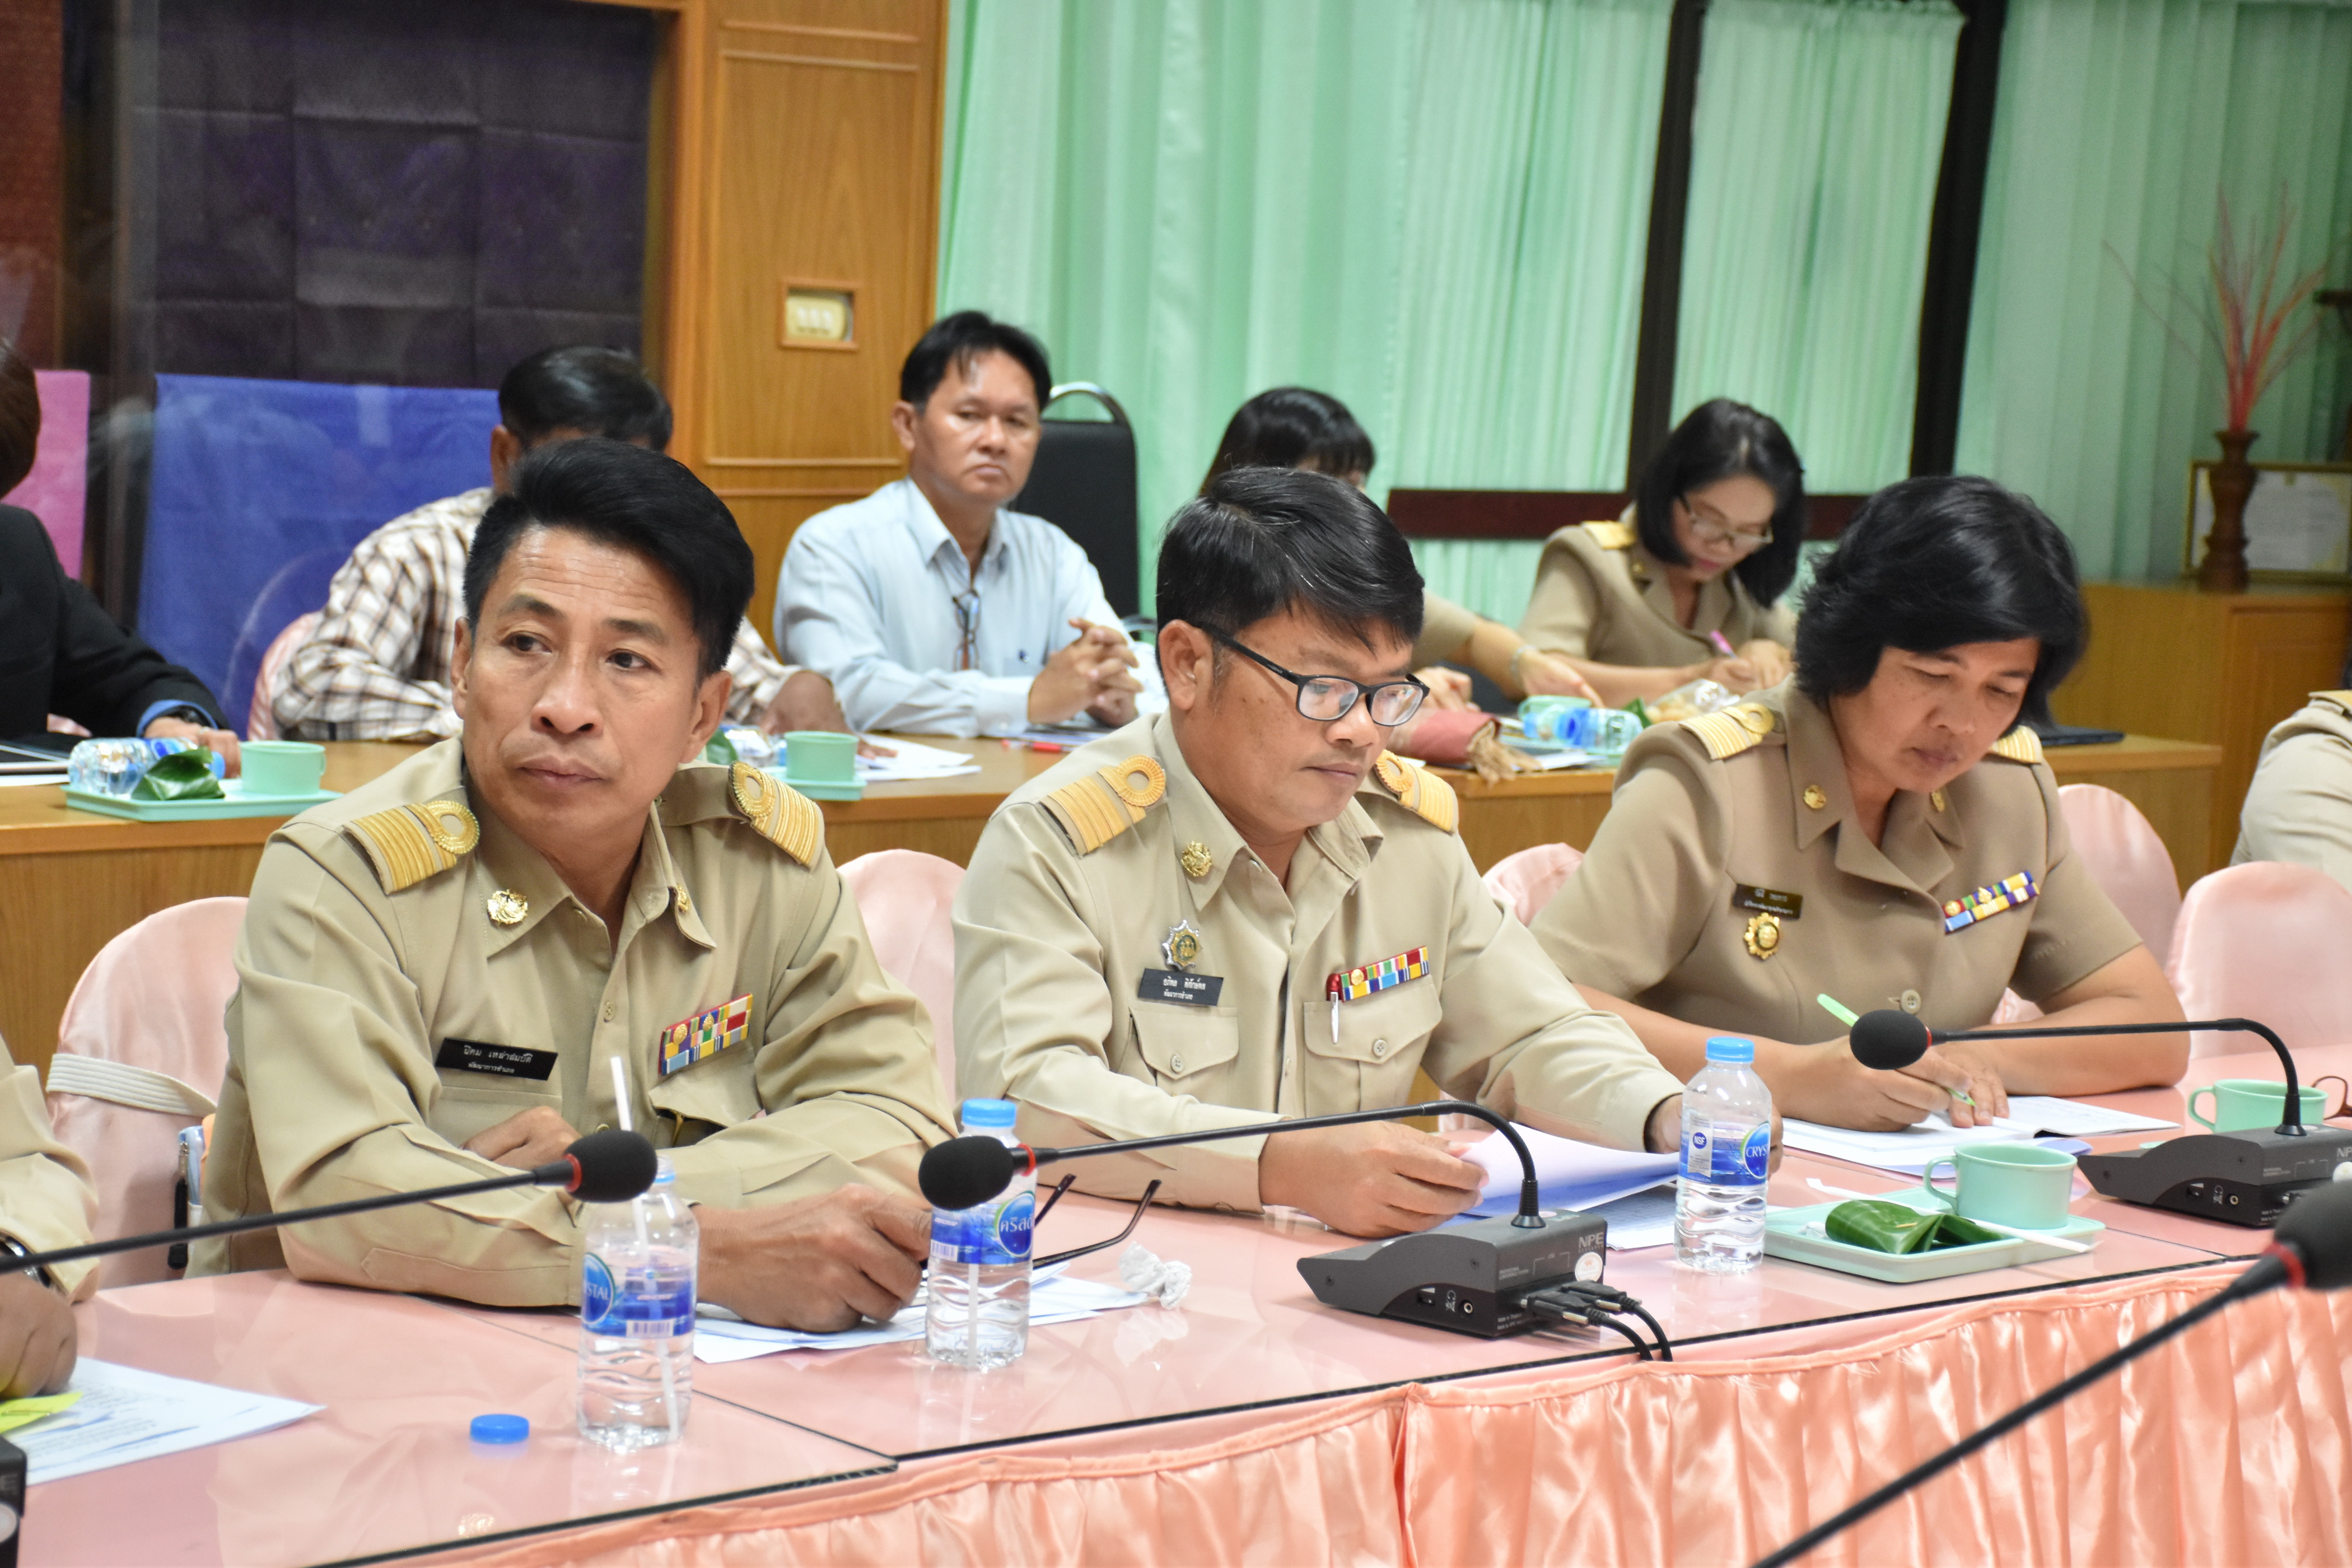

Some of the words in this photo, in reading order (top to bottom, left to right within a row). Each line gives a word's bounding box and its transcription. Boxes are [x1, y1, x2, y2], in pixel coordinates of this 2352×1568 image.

[1693, 1136, 1705, 1146] NSF
[1746, 1144, 1767, 1158] CRYS
[1579, 1232, 1604, 1248] NPE
